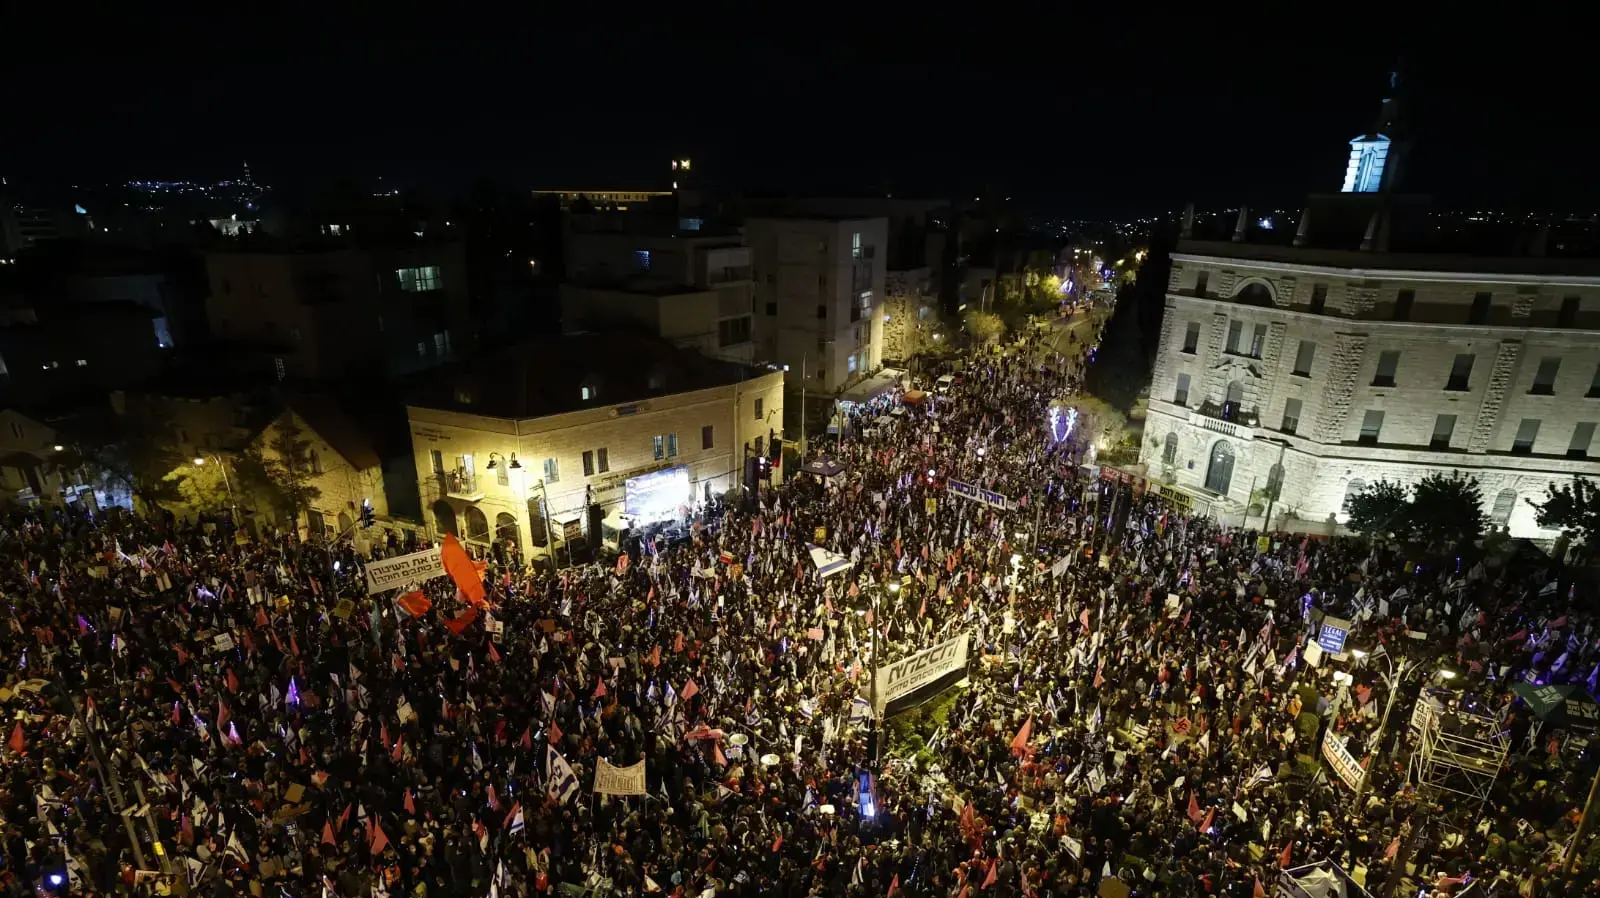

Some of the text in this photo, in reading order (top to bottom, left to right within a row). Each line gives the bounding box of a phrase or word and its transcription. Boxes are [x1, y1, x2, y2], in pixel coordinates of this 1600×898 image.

[979, 488, 1004, 507] חוקה
[372, 560, 410, 575] השיטה
[412, 556, 429, 567] את
[401, 565, 432, 577] כותבים
[375, 572, 401, 585] חוקה
